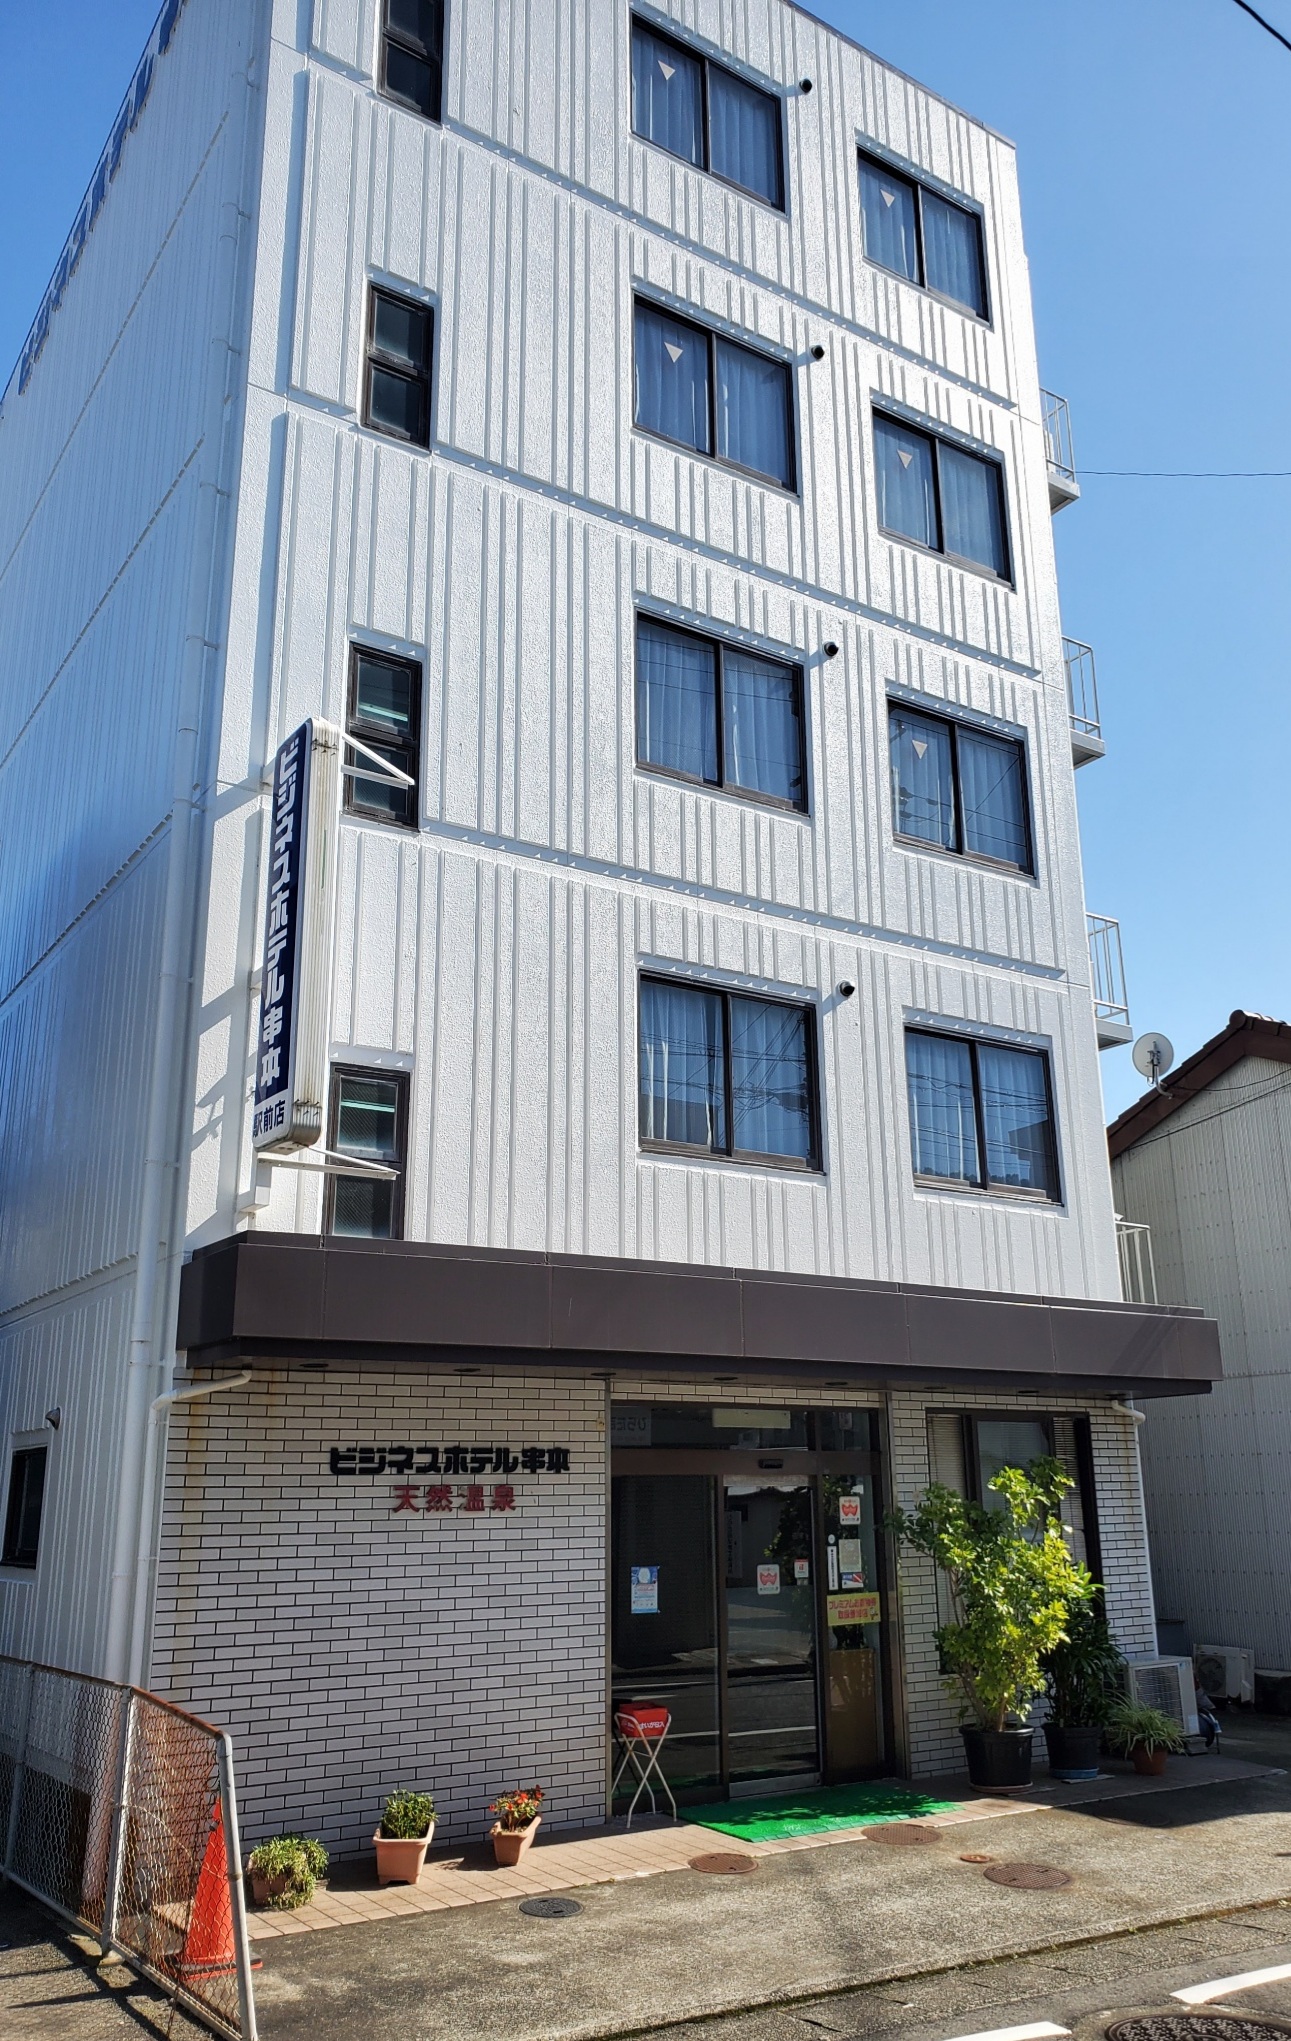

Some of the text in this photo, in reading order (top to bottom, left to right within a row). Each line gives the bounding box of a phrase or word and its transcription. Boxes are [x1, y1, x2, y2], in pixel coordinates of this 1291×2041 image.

[261, 737, 300, 1088] ビジネスホテル串本
[253, 1099, 286, 1138] 駅前店
[330, 1446, 570, 1475] ビジネスホテル串本
[393, 1485, 516, 1513] 天然温泉
